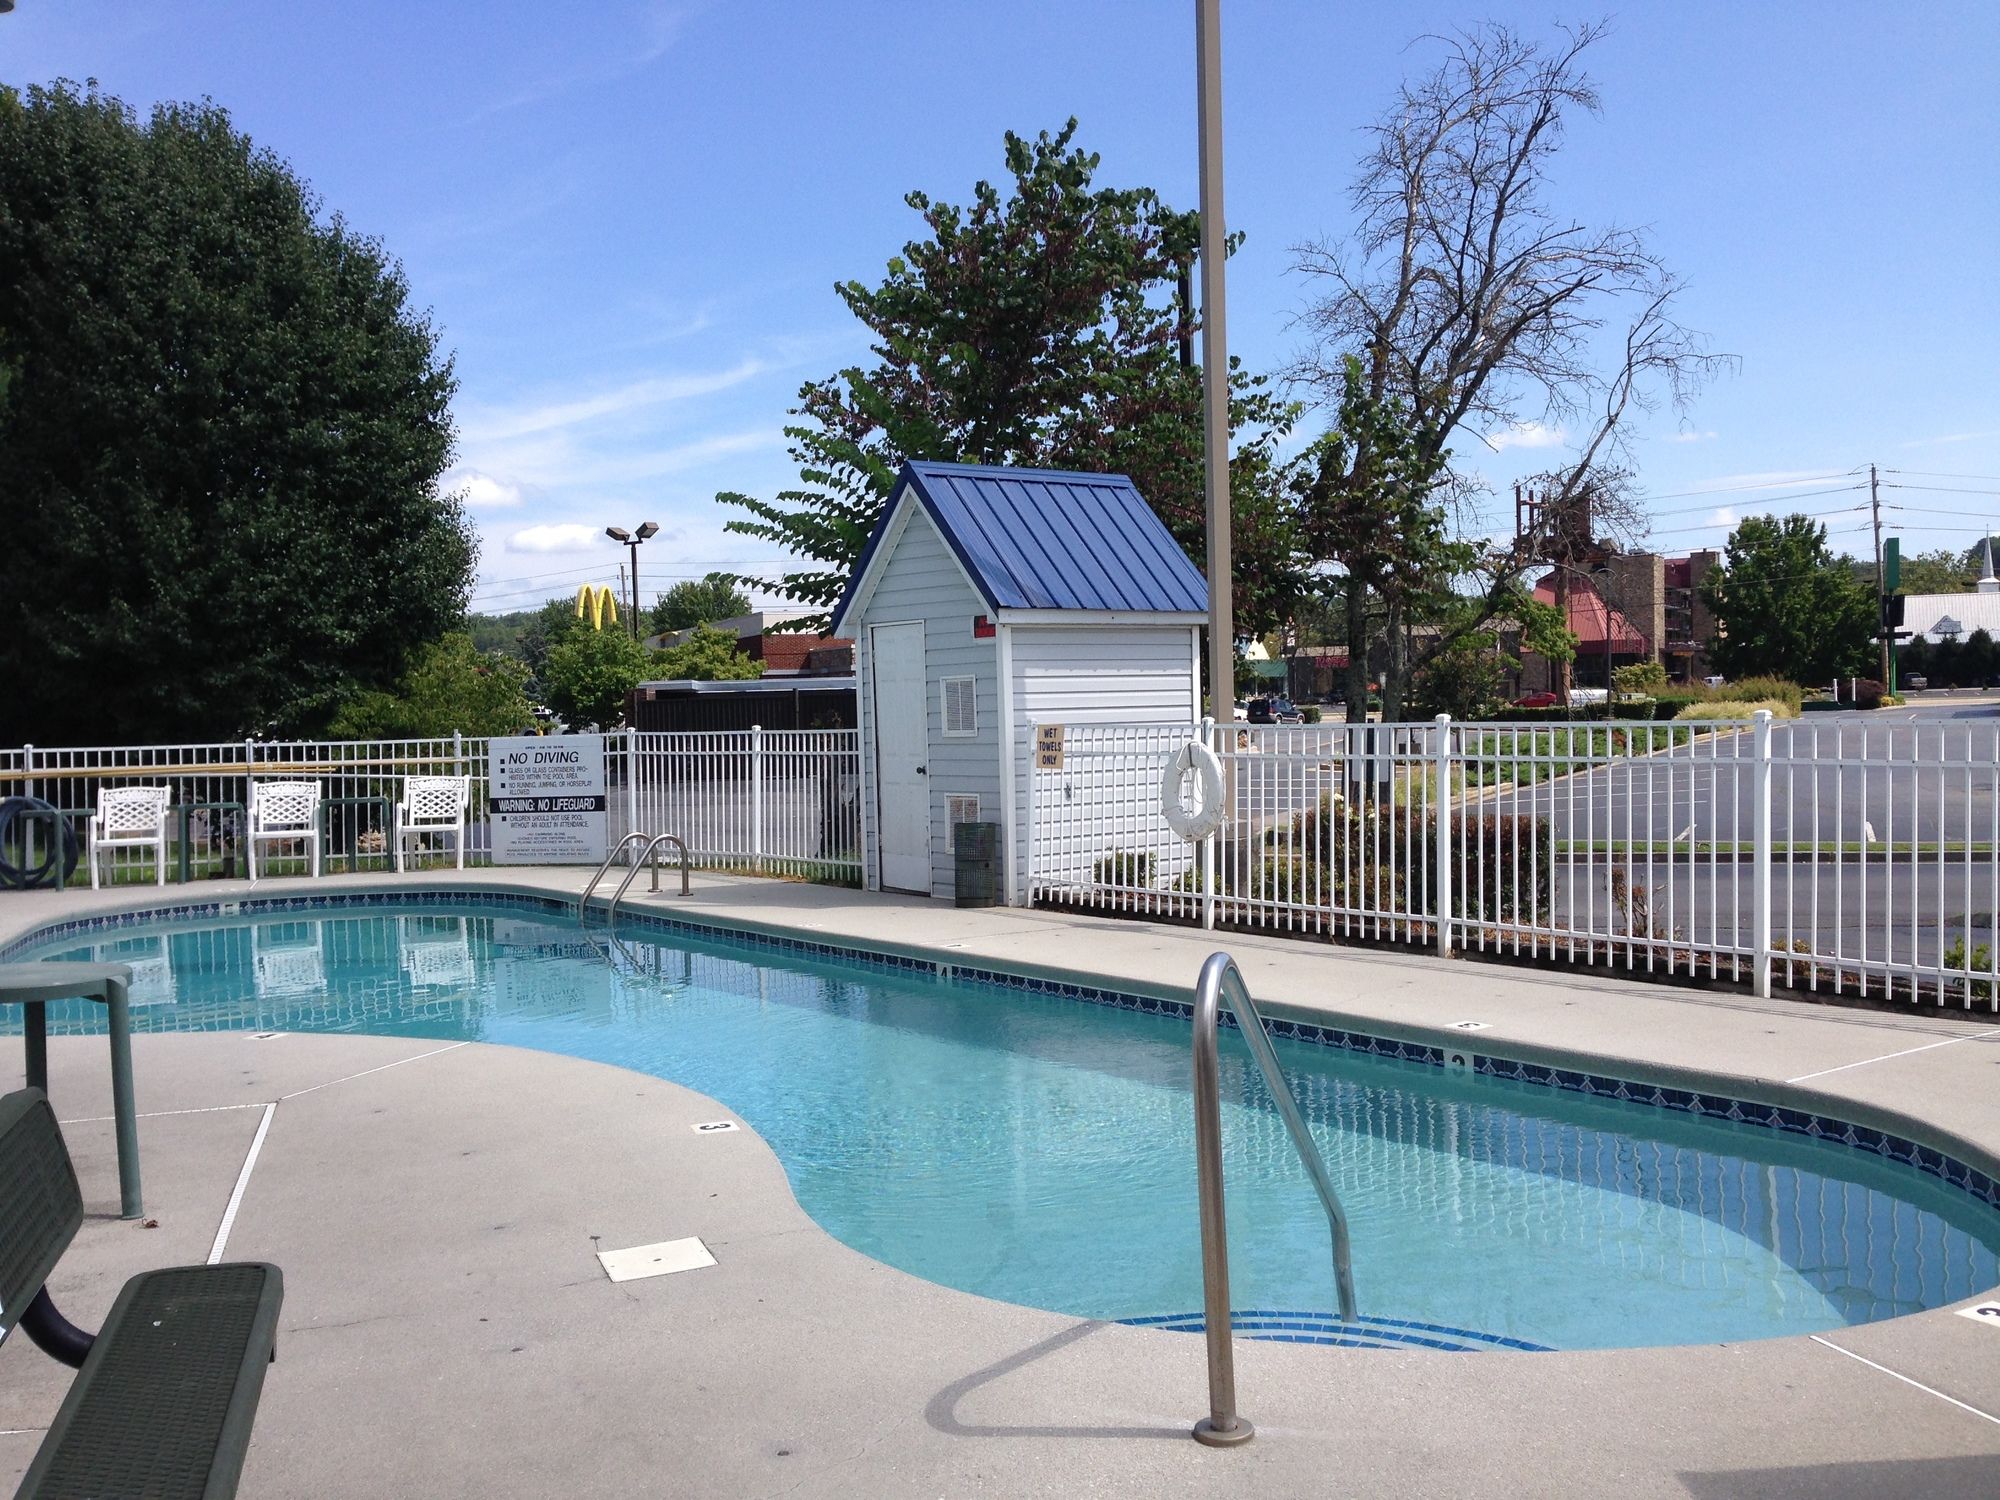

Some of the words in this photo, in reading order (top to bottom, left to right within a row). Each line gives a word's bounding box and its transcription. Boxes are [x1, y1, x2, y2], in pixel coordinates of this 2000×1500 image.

[1043, 727, 1058, 738] WET
[1038, 741, 1062, 752] TOWELS
[508, 752, 528, 765] NO
[534, 751, 579, 764] DIVING
[1042, 754, 1057, 765] ONLY
[498, 798, 536, 812] WARNING:
[537, 798, 550, 811] NO
[552, 797, 595, 811] LIFEGUARD
[699, 1122, 732, 1131] 3
